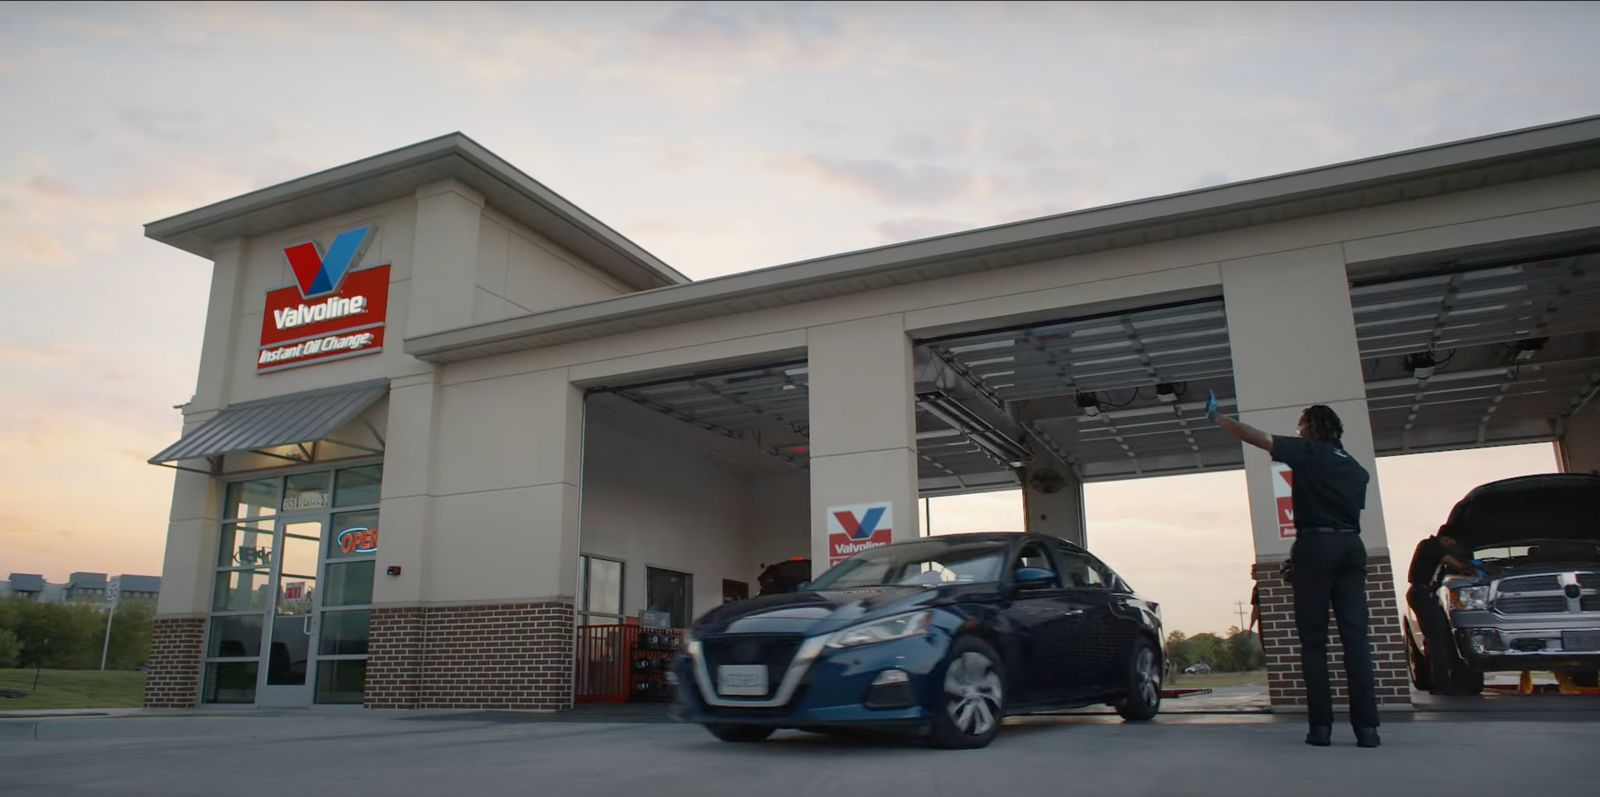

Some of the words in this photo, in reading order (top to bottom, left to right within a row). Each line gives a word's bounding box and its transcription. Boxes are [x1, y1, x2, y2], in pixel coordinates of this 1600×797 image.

[273, 295, 364, 329] Valvoline
[259, 344, 302, 363] Instant
[303, 339, 322, 355] Oil
[321, 333, 371, 349] Change
